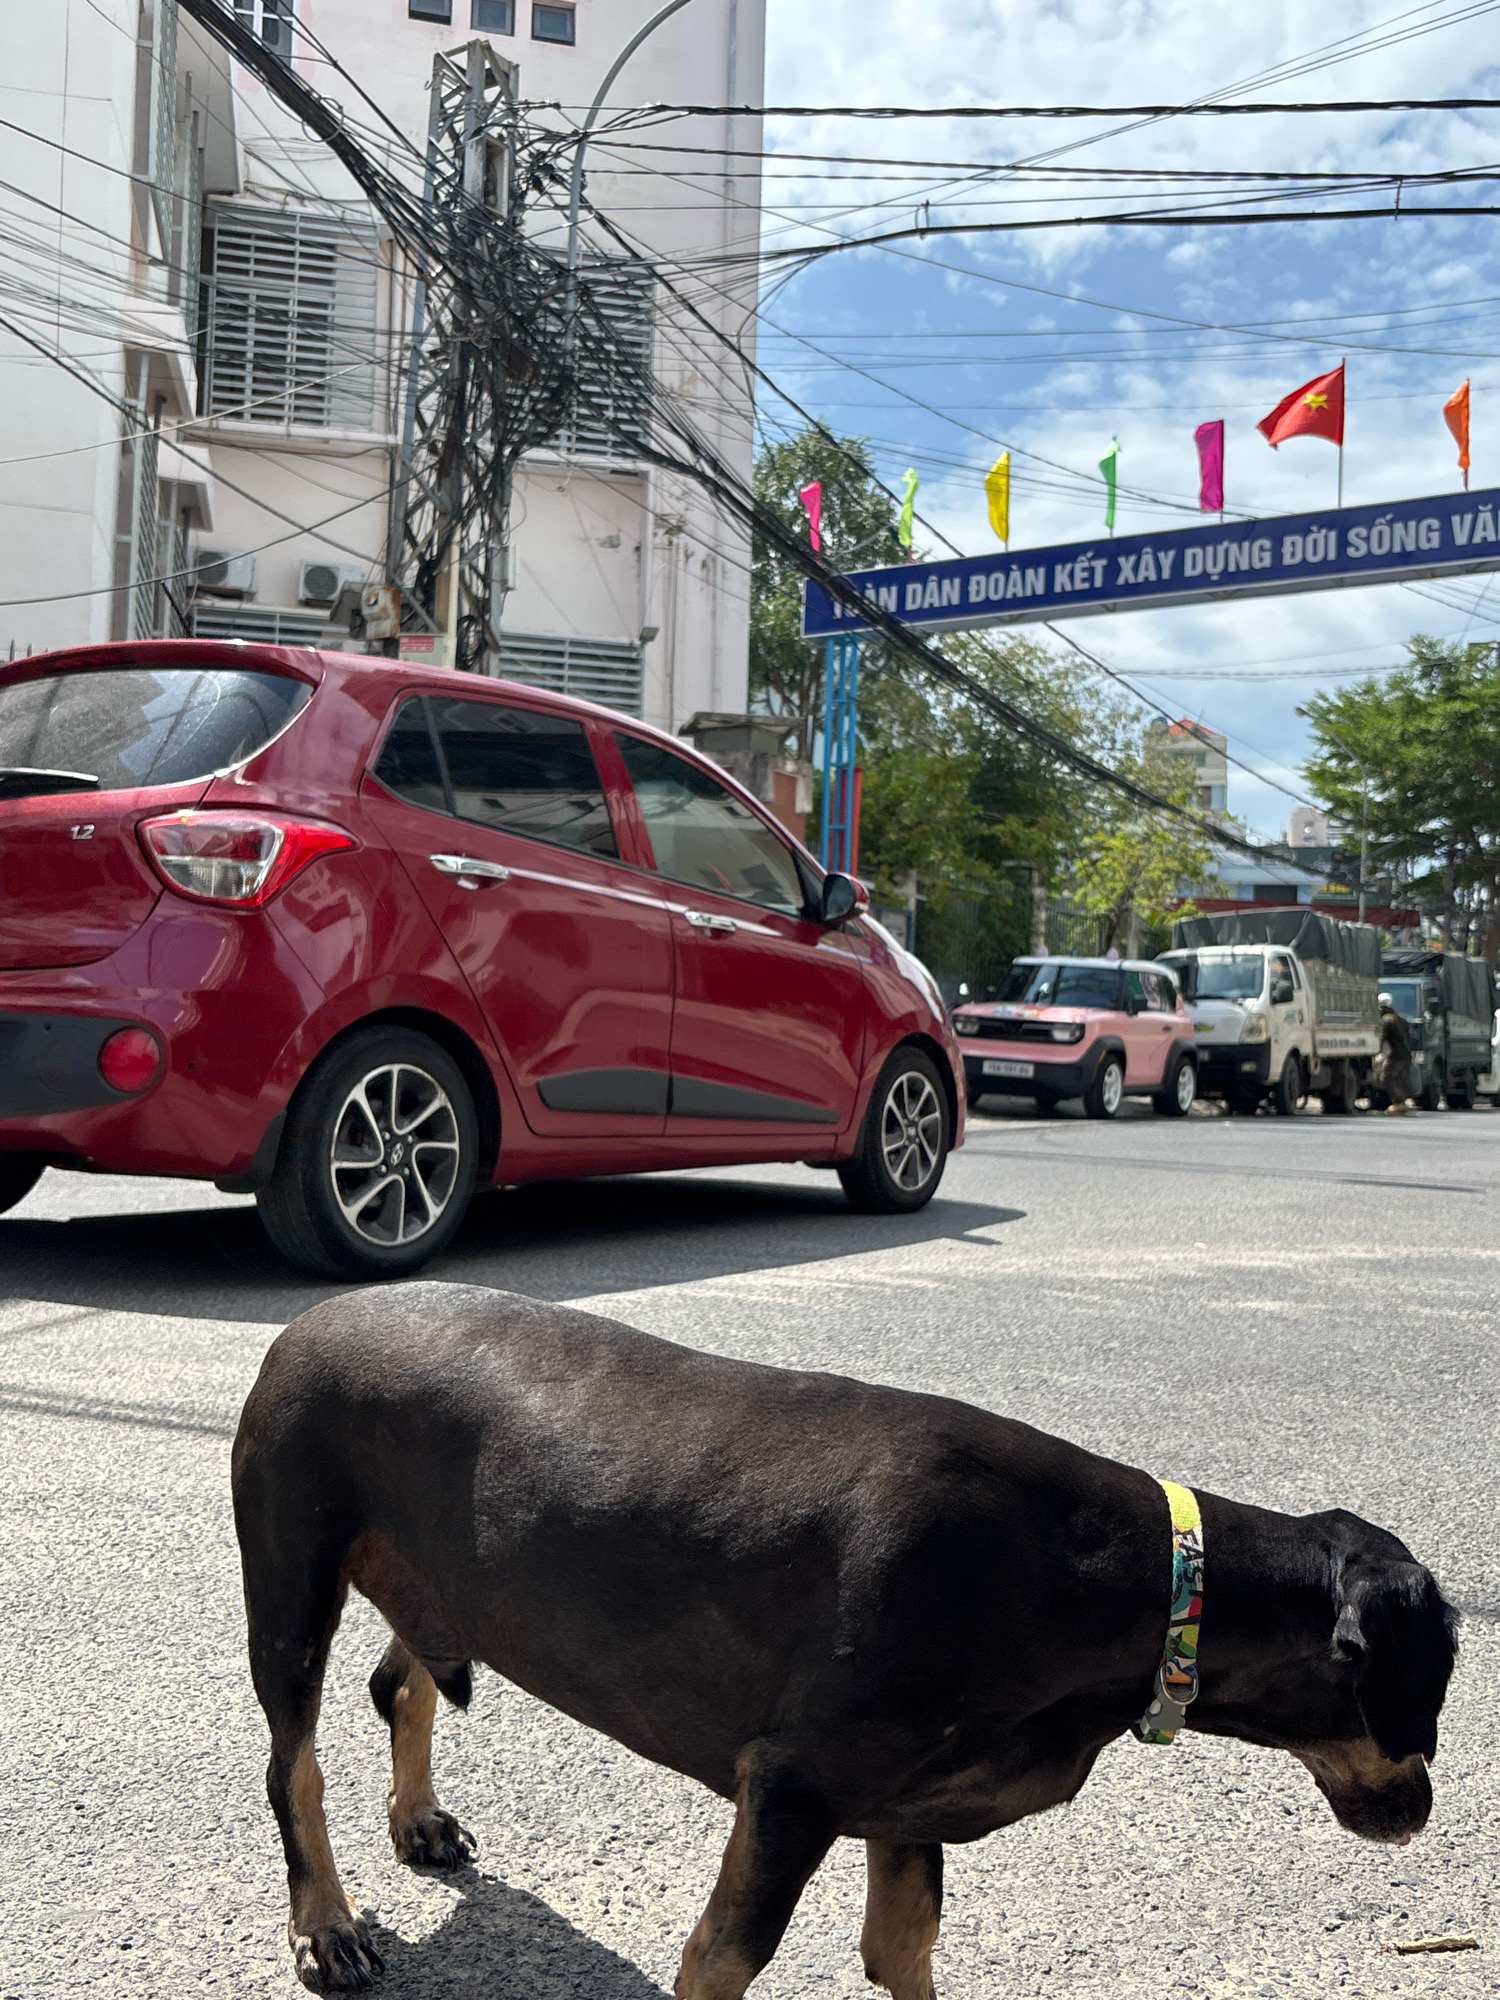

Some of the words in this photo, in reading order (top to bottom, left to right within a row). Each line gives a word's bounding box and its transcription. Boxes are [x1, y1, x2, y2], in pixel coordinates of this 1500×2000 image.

[905, 574, 961, 612] DÂN
[968, 564, 1046, 603] ĐOÀN
[1053, 551, 1108, 593] KẾT
[1116, 545, 1177, 586] XÂY
[1183, 538, 1273, 581] DỰNG
[1281, 523, 1338, 567] ĐỜI
[1346, 512, 1441, 559] SỐNG
[1451, 503, 1500, 546] VĂ
